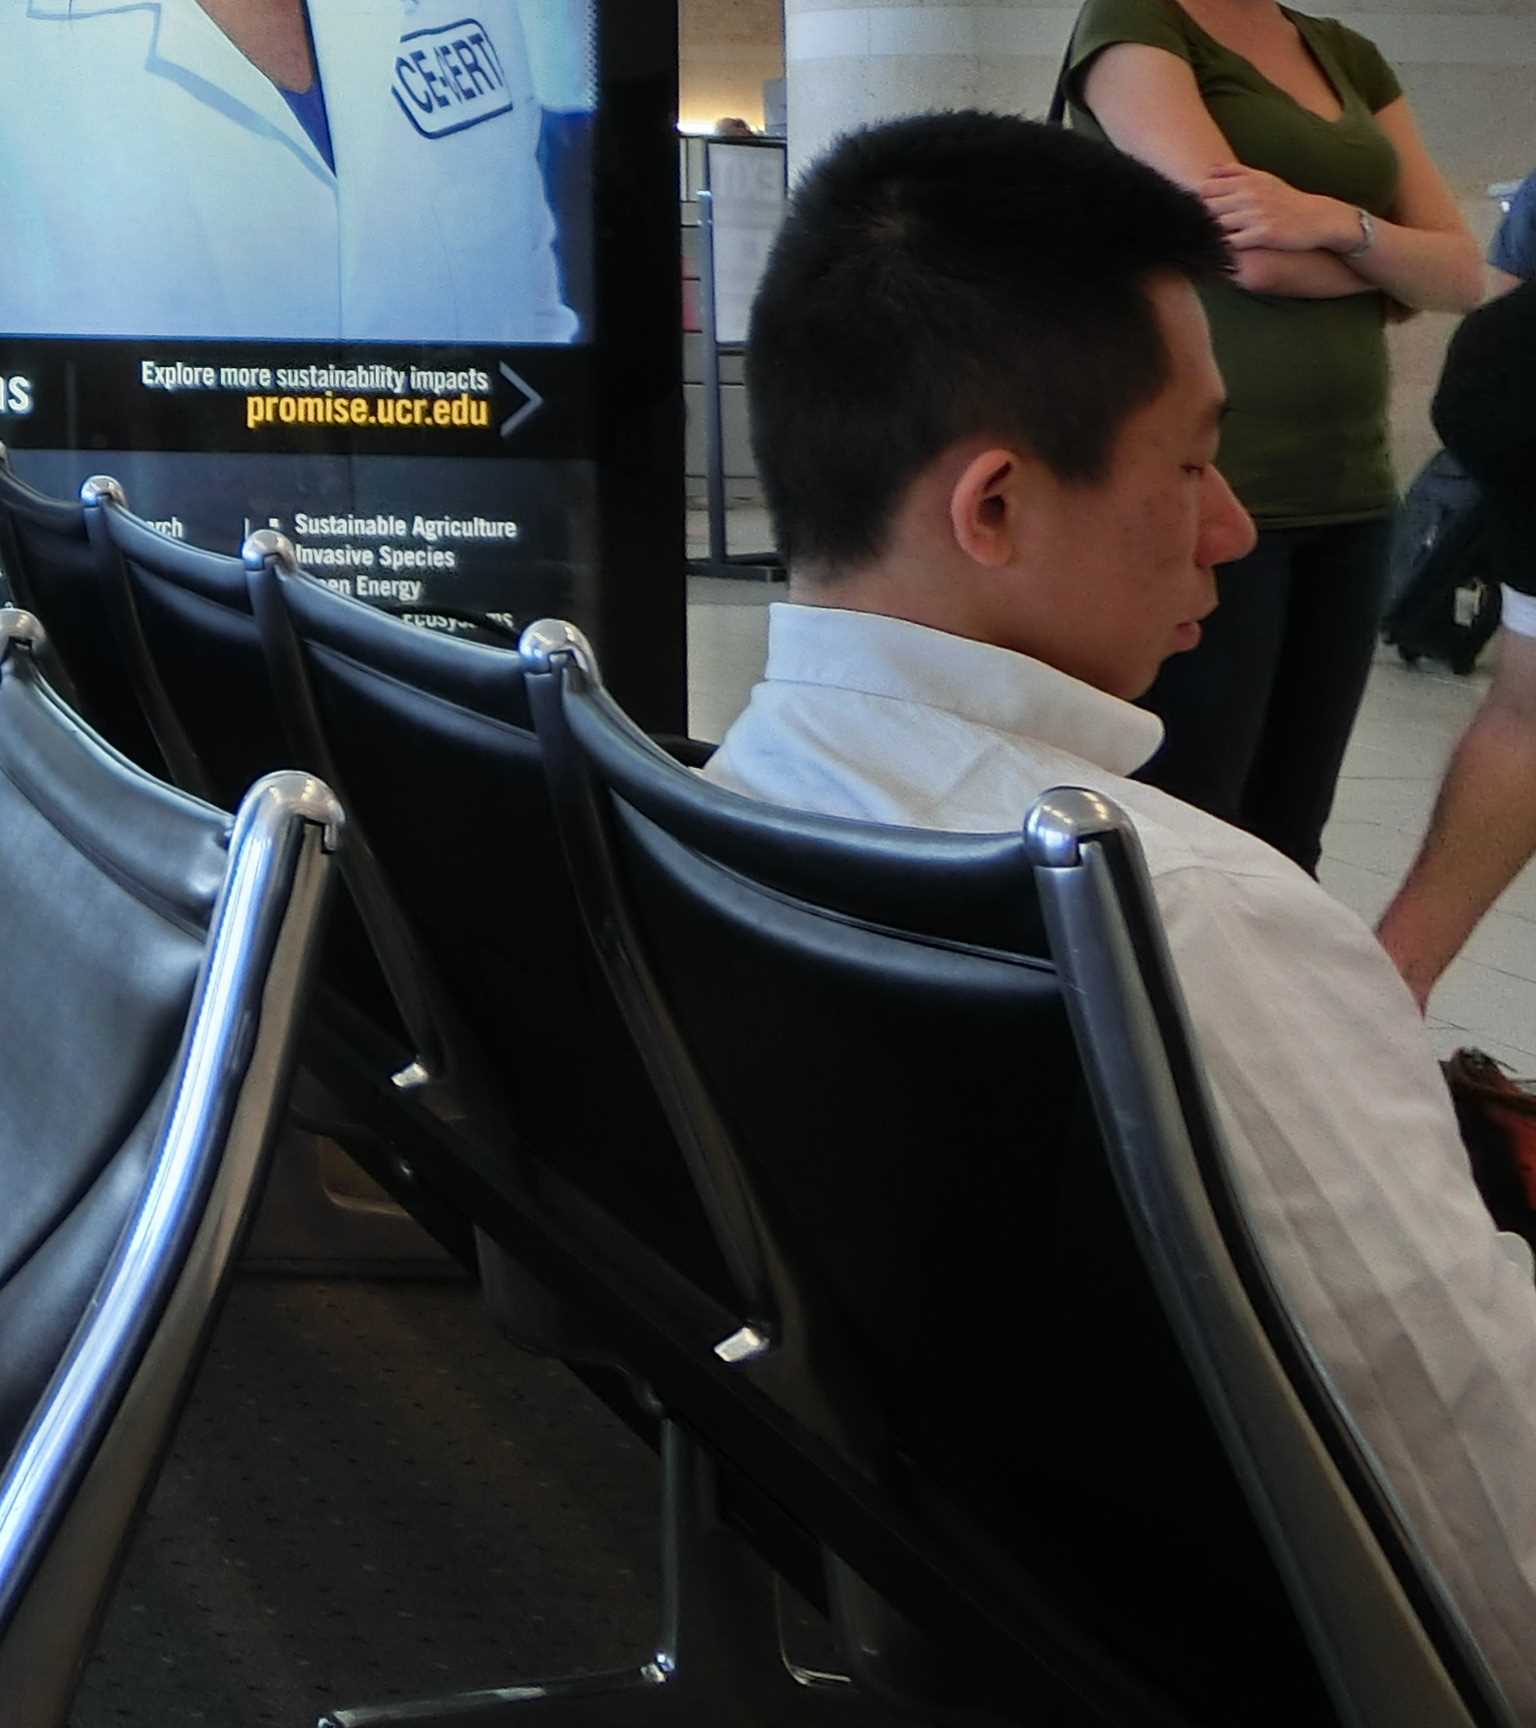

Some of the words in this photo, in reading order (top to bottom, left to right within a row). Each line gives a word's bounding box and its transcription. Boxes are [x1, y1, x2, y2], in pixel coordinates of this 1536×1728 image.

[141, 360, 215, 390] Explore
[220, 367, 271, 388] more
[276, 364, 405, 393] sustainability
[410, 366, 489, 394] impacts
[246, 392, 488, 428] promise.ucr.edu
[295, 513, 407, 537] Sustainable
[412, 515, 518, 541] Agriculture
[295, 543, 375, 566] Invasive
[379, 545, 456, 570] Species
[356, 575, 422, 601] Energy
